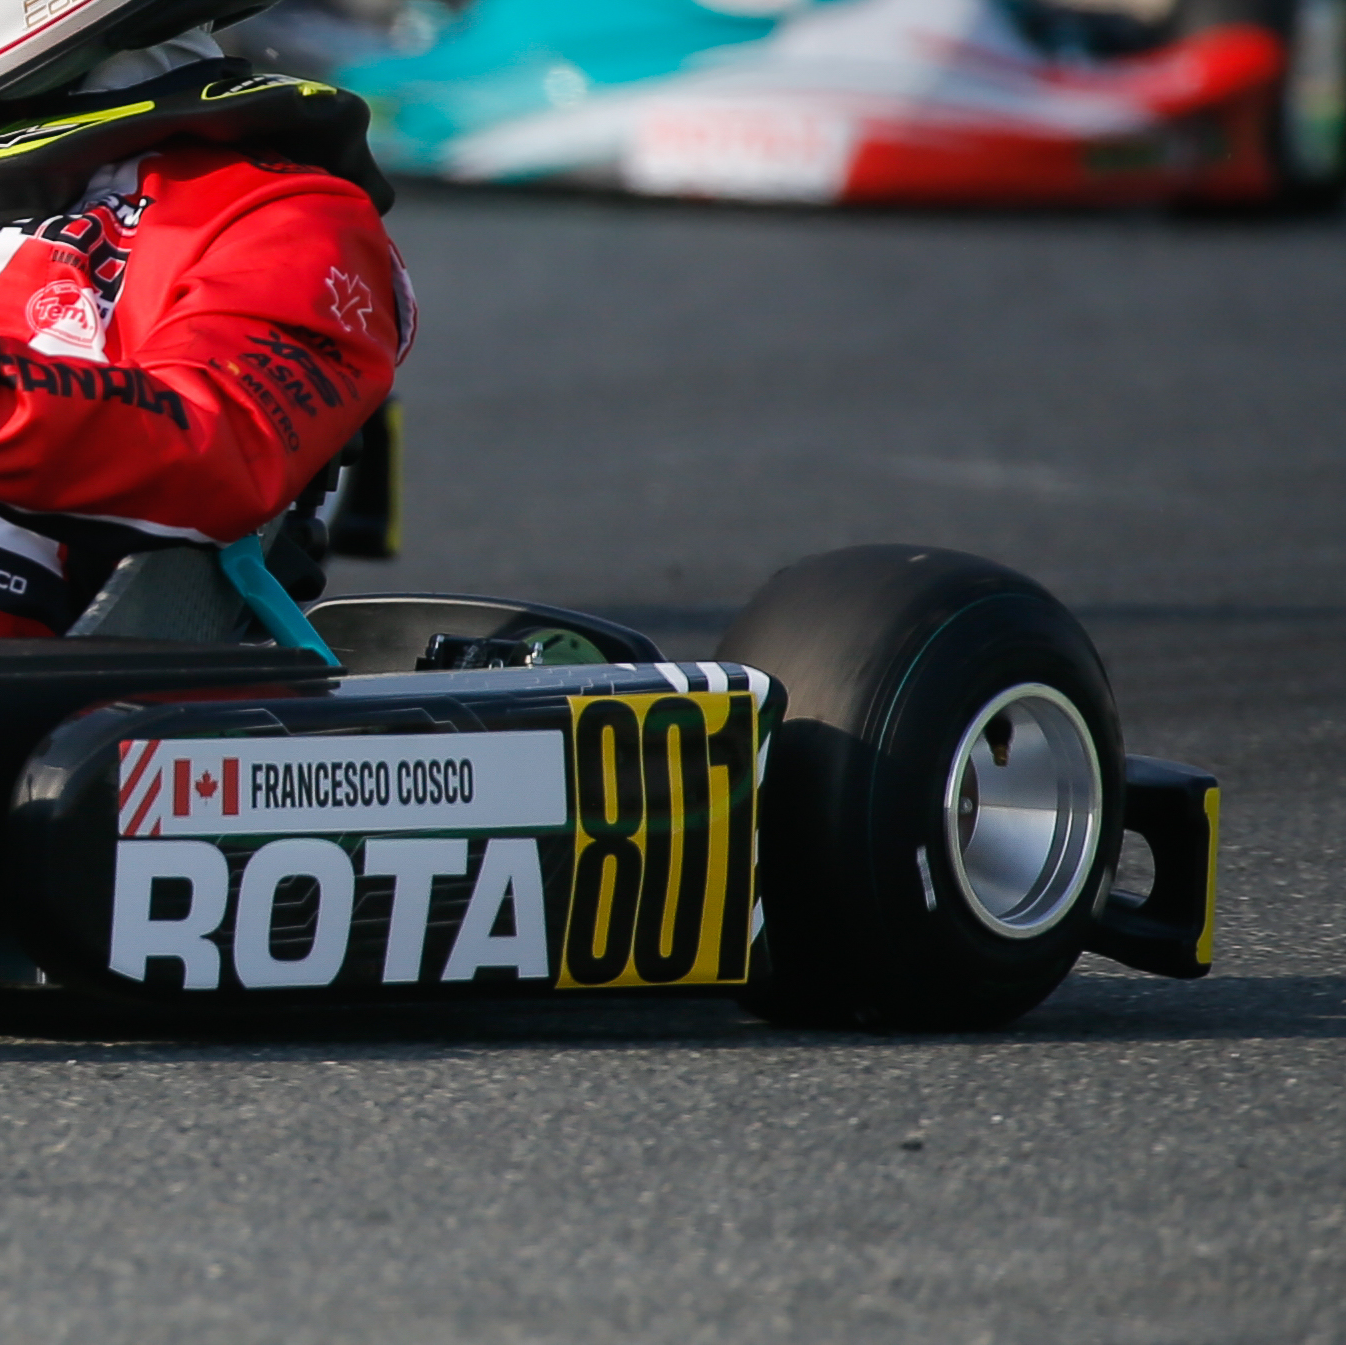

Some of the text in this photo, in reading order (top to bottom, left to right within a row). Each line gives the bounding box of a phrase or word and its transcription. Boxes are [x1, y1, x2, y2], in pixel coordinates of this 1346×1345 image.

[250, 757, 475, 809] FRANCESCO COSCO
[565, 694, 754, 986] 801
[109, 836, 551, 991] ROTA
